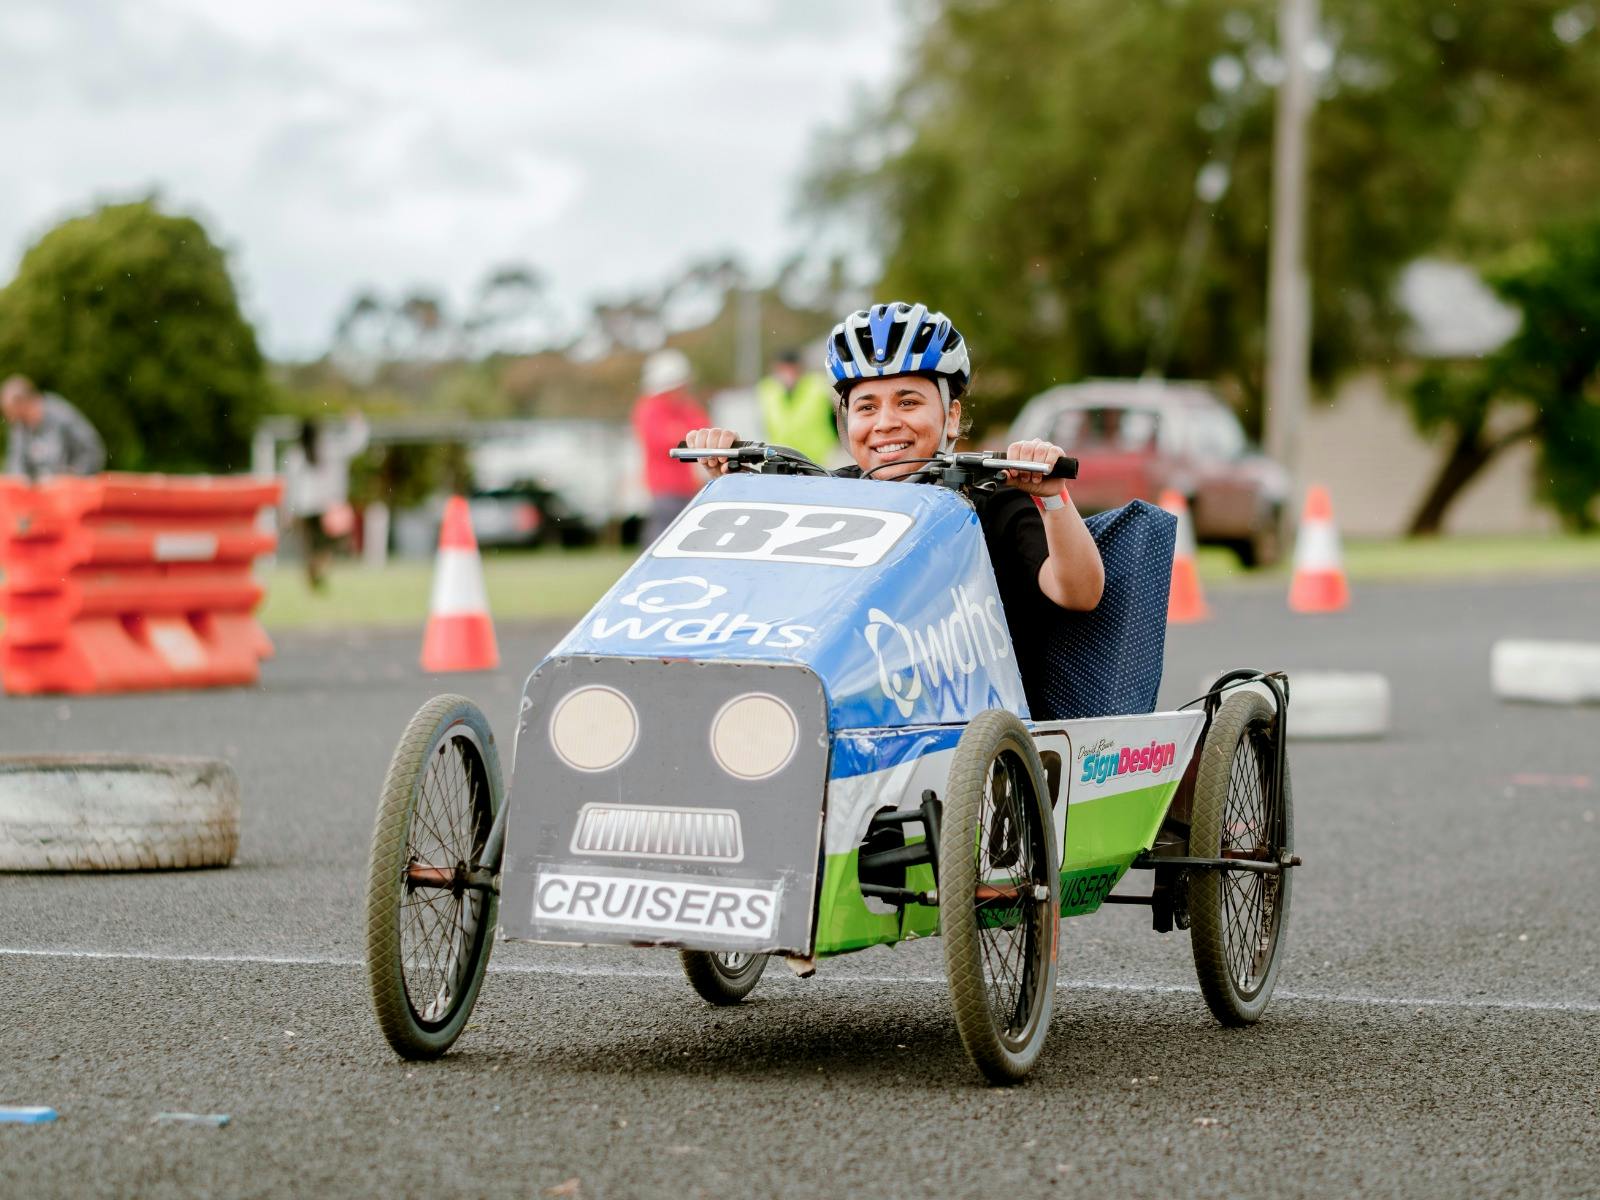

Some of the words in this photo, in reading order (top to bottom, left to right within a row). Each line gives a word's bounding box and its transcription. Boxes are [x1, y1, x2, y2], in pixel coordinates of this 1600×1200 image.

[677, 508, 887, 561] 82
[591, 612, 815, 648] wdhs
[914, 584, 1009, 688] wdhs
[1081, 741, 1175, 784] SignDesign
[538, 879, 771, 931] CRUISERS
